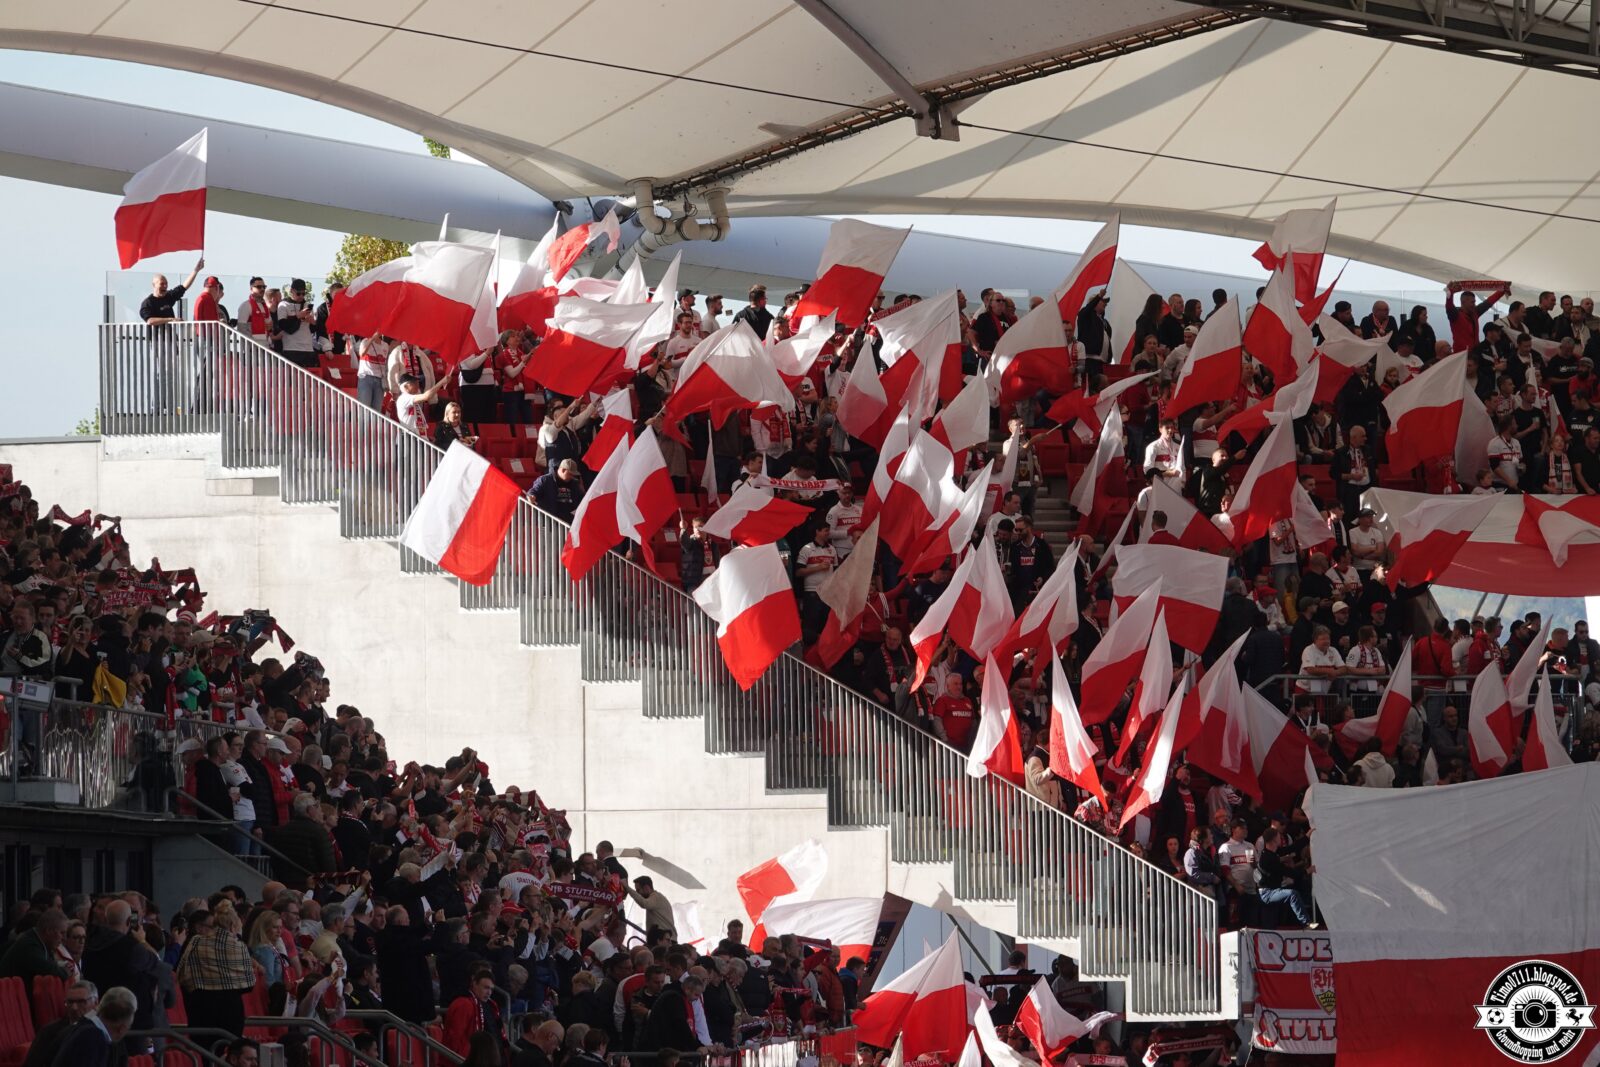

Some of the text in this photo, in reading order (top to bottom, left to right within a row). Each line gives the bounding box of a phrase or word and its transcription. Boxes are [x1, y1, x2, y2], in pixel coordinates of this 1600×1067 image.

[770, 478, 826, 488] STUTTGART
[1253, 931, 1333, 971] RUDE
[1256, 1010, 1337, 1047] STUTT
